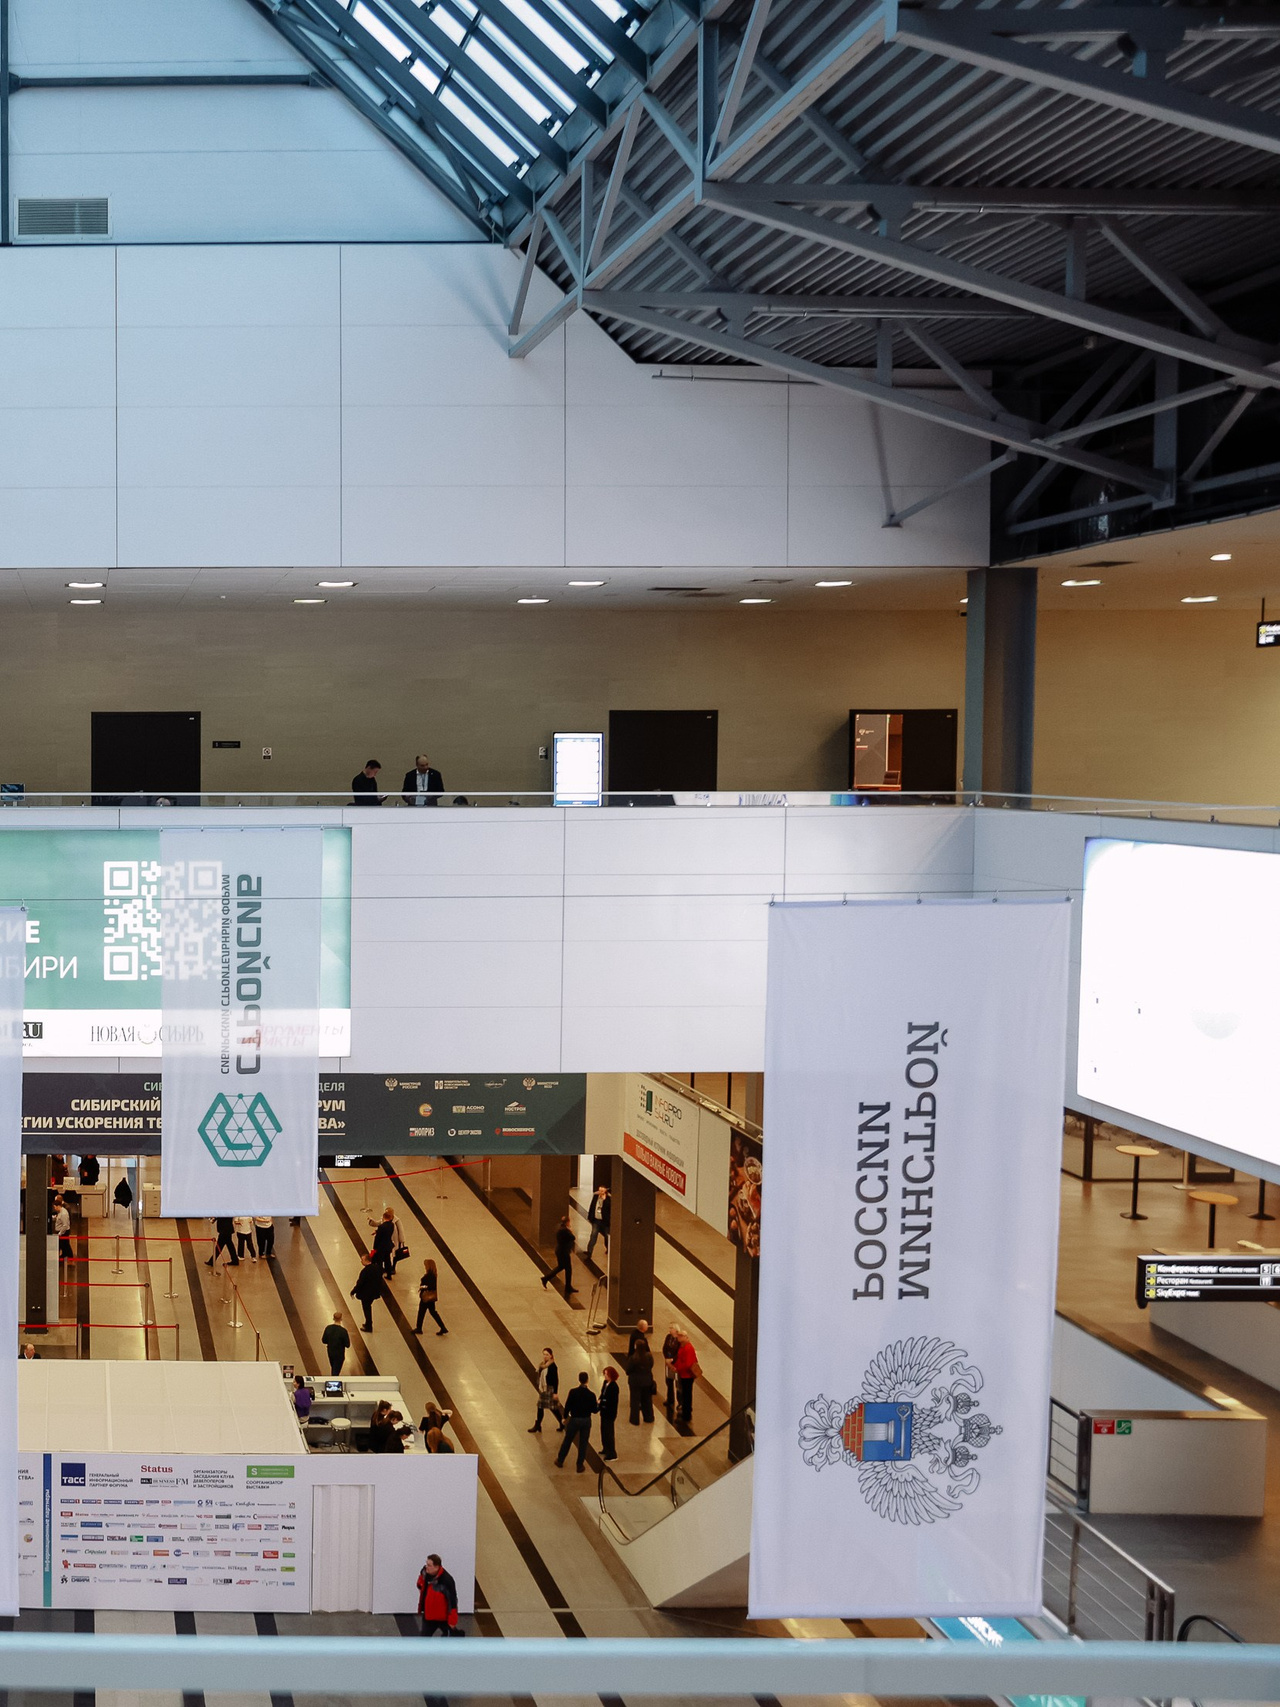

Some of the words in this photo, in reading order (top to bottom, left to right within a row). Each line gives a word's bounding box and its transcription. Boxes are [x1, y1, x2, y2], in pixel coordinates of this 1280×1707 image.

[91, 1025, 135, 1043] НОВАЯ
[71, 1097, 161, 1112] СИБИРСКИЙ
[21, 1117, 53, 1129] ГИИ
[56, 1117, 143, 1129] УСКОРЕНИЯ
[1156, 1277, 1188, 1286] Ресторан
[1156, 1288, 1186, 1298] SkyExpo
[141, 1464, 173, 1473] Status
